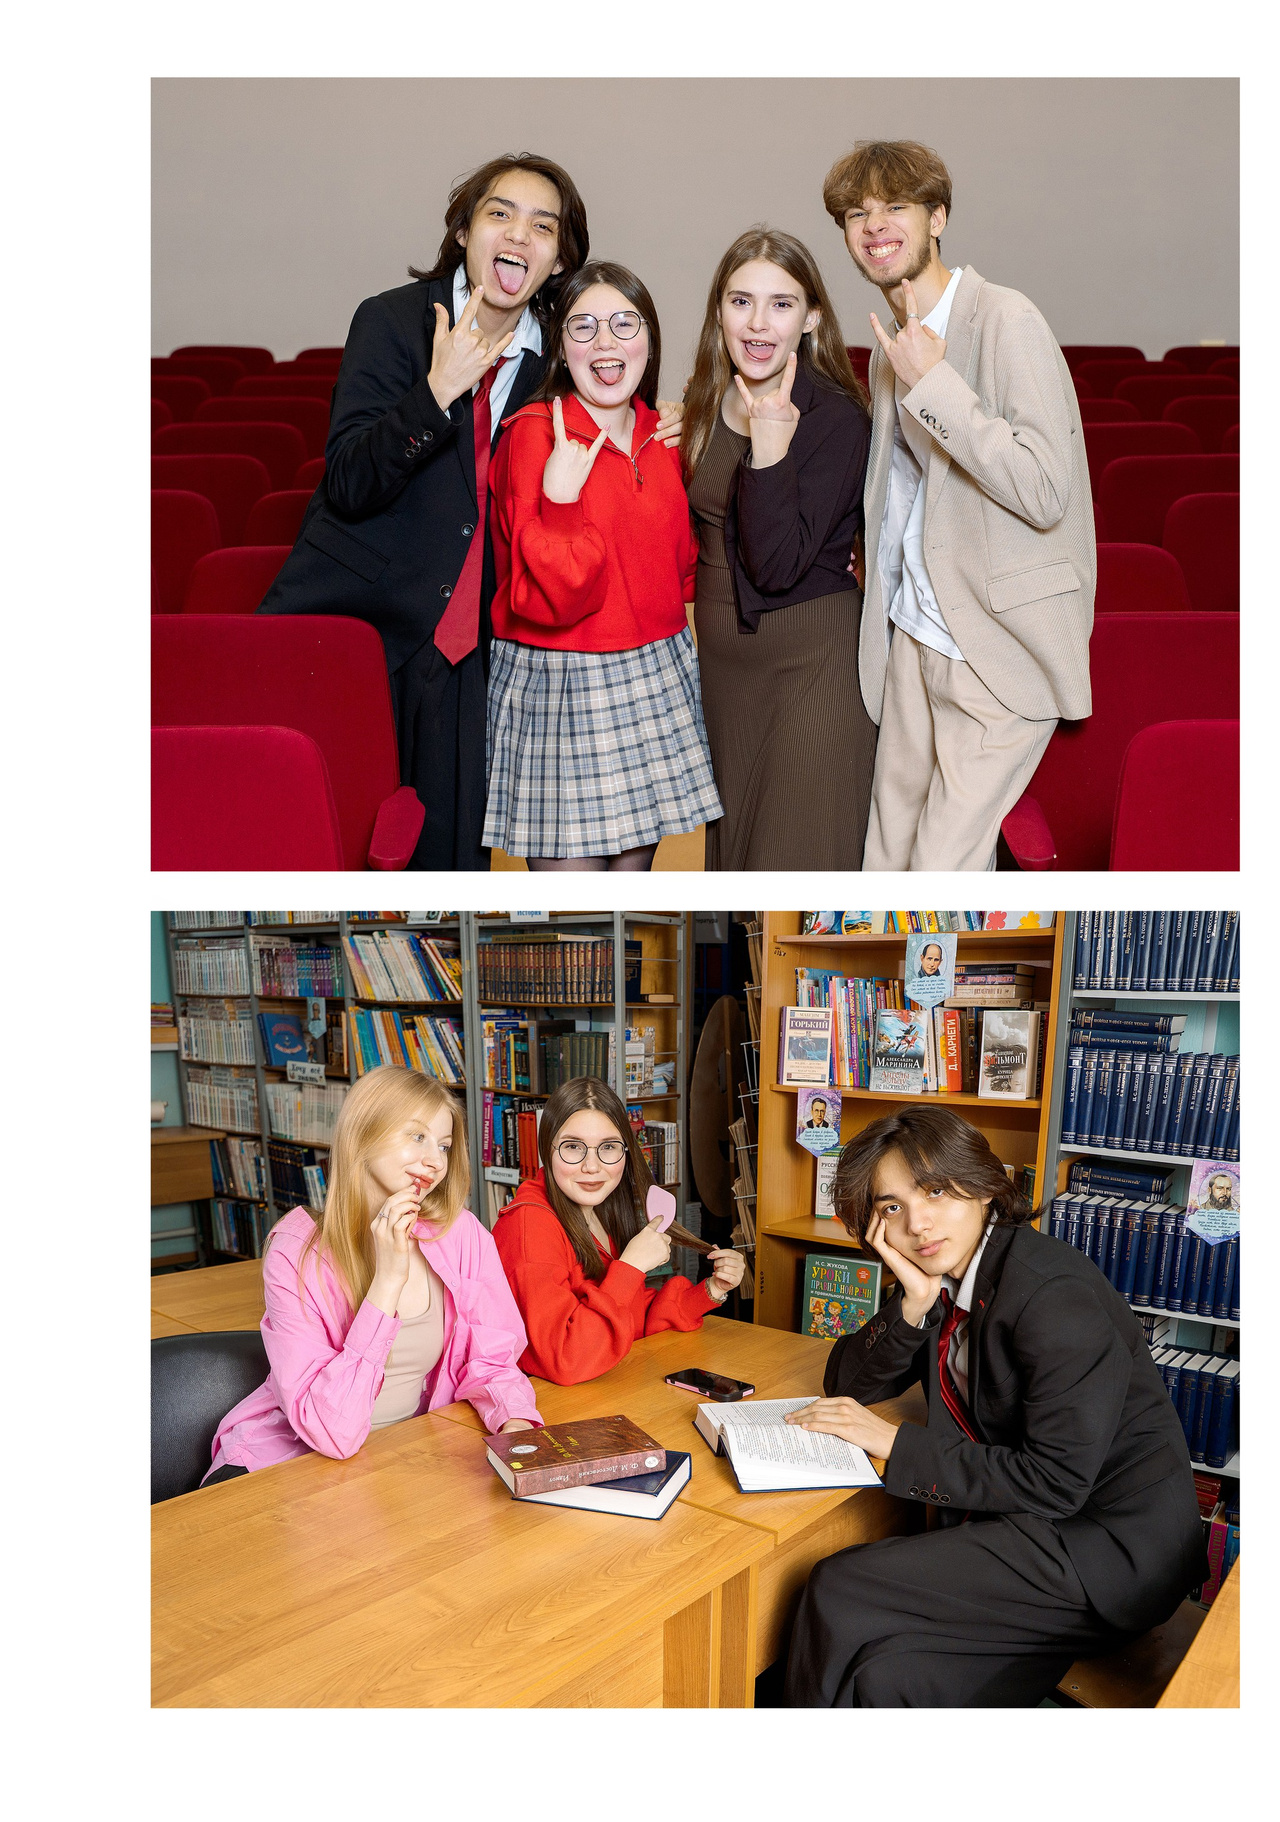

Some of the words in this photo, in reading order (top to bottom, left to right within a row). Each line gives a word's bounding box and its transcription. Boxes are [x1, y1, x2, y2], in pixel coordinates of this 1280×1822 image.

[790, 1020, 829, 1030] ГОРЬКИЙ
[876, 1056, 921, 1070] МАРИНИНА
[812, 1266, 850, 1284] УРОКИ
[811, 1279, 854, 1295] ПРАВИЛЬНОЙ
[854, 1287, 872, 1299] РЕЧИ
[579, 1465, 617, 1477] Достоевский
[549, 1475, 569, 1483] Идиот
